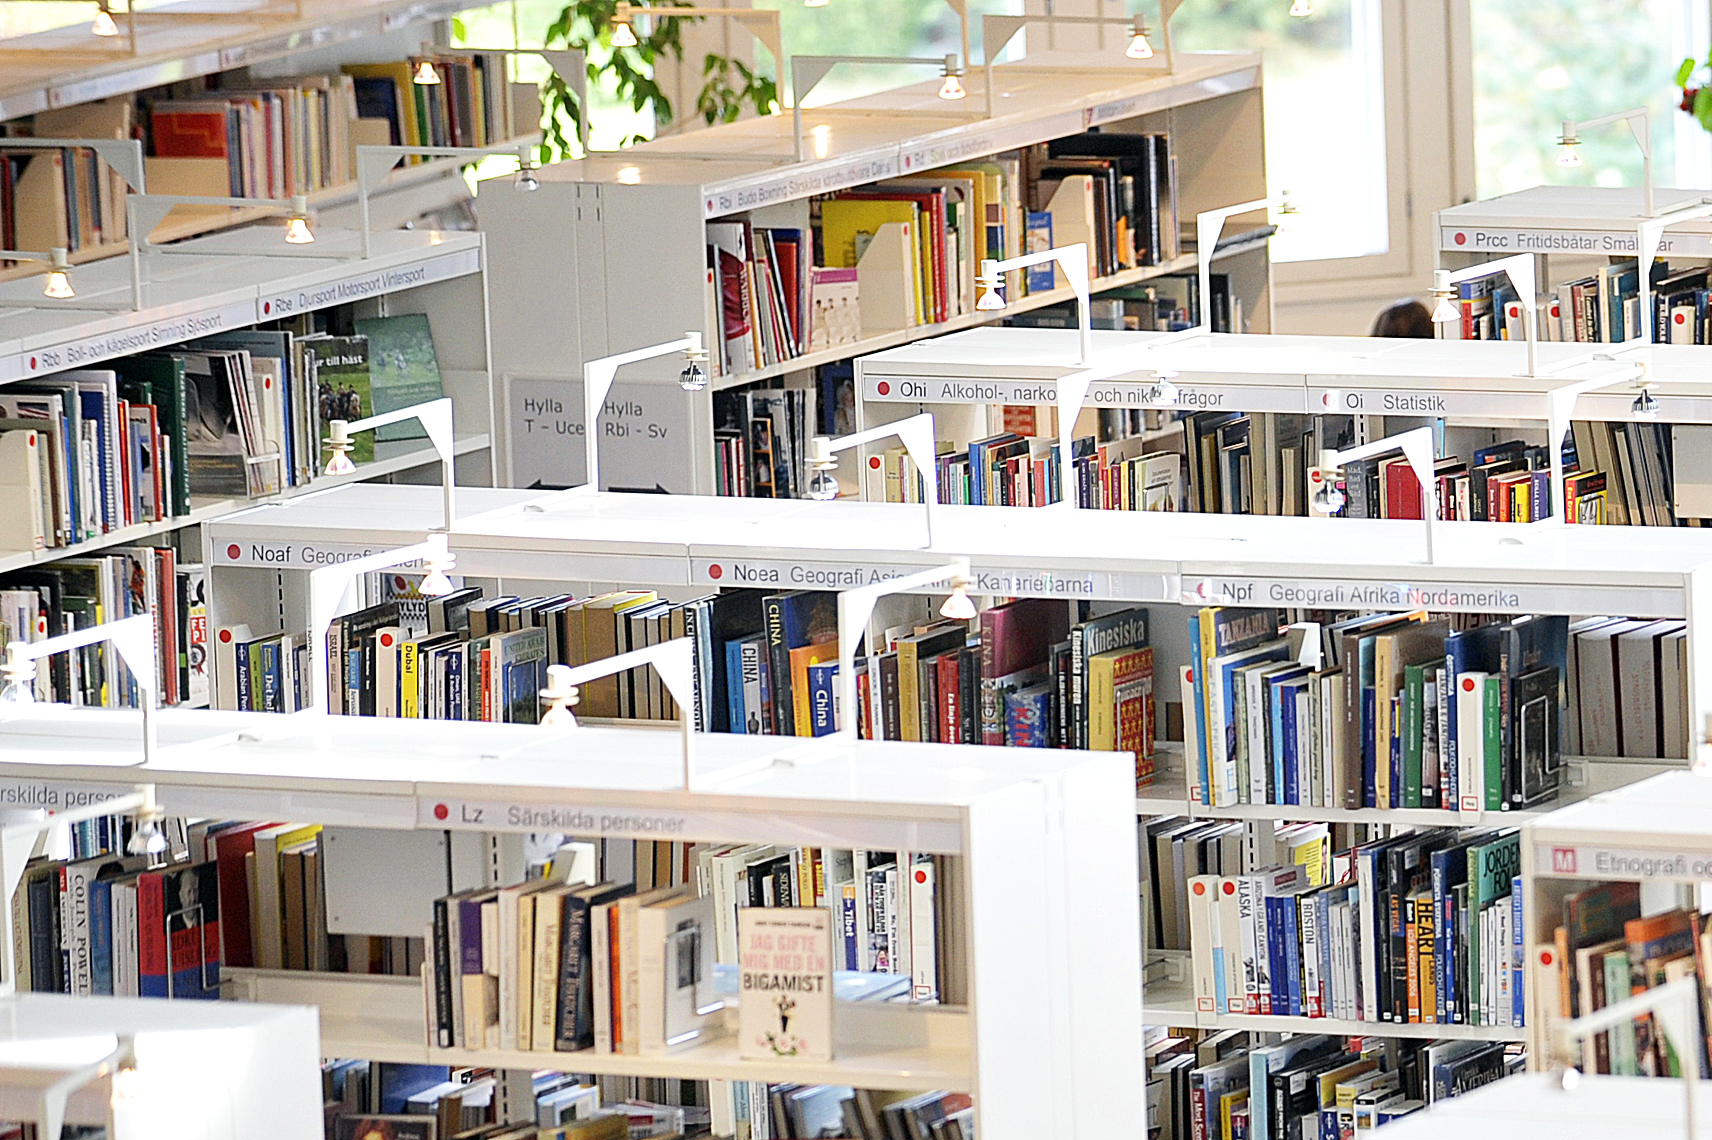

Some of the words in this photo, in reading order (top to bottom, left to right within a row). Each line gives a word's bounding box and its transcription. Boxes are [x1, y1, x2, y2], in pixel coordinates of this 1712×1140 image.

[1476, 232, 1508, 248] Prcc
[1517, 233, 1598, 250] Fritidsbåtar
[1602, 235, 1673, 252] Småar
[340, 353, 364, 365] häst
[900, 380, 927, 399] Ohi
[941, 384, 1008, 402] Alkohol-,
[1094, 388, 1123, 403] och
[1346, 392, 1364, 410] Oi
[1383, 394, 1445, 411] Statistik
[524, 397, 563, 415] Hylla
[604, 400, 643, 417] Hylla
[525, 419, 534, 434] T
[605, 421, 629, 437] Rbi
[649, 423, 668, 439] Sv
[252, 544, 291, 563] Noaf
[734, 564, 779, 582] Noea
[790, 567, 863, 586] Geografi
[1222, 582, 1253, 603] Npf
[1269, 584, 1345, 605] Geografi
[1349, 586, 1400, 605] Afrika
[1406, 588, 1520, 608] Nordamerika
[768, 604, 781, 646] CHINA
[1087, 617, 1145, 656] Kinesiska
[329, 634, 337, 659] ISRAEL
[742, 648, 758, 684] CHINA
[239, 666, 248, 694] Arabian
[816, 689, 828, 727] China
[0, 786, 58, 805] rskilda
[462, 804, 484, 824] Lz
[507, 806, 595, 830] Särskilda
[600, 814, 685, 835] personer
[1595, 853, 1688, 878] Etnografi
[73, 875, 86, 930] COLIN
[1238, 880, 1251, 918] ALASKA
[845, 910, 854, 937] Tibet
[1303, 904, 1314, 944] BOSTON
[1417, 902, 1434, 958] HEART
[742, 973, 825, 993] BIGAMIST
[1193, 1103, 1203, 1122] Most
